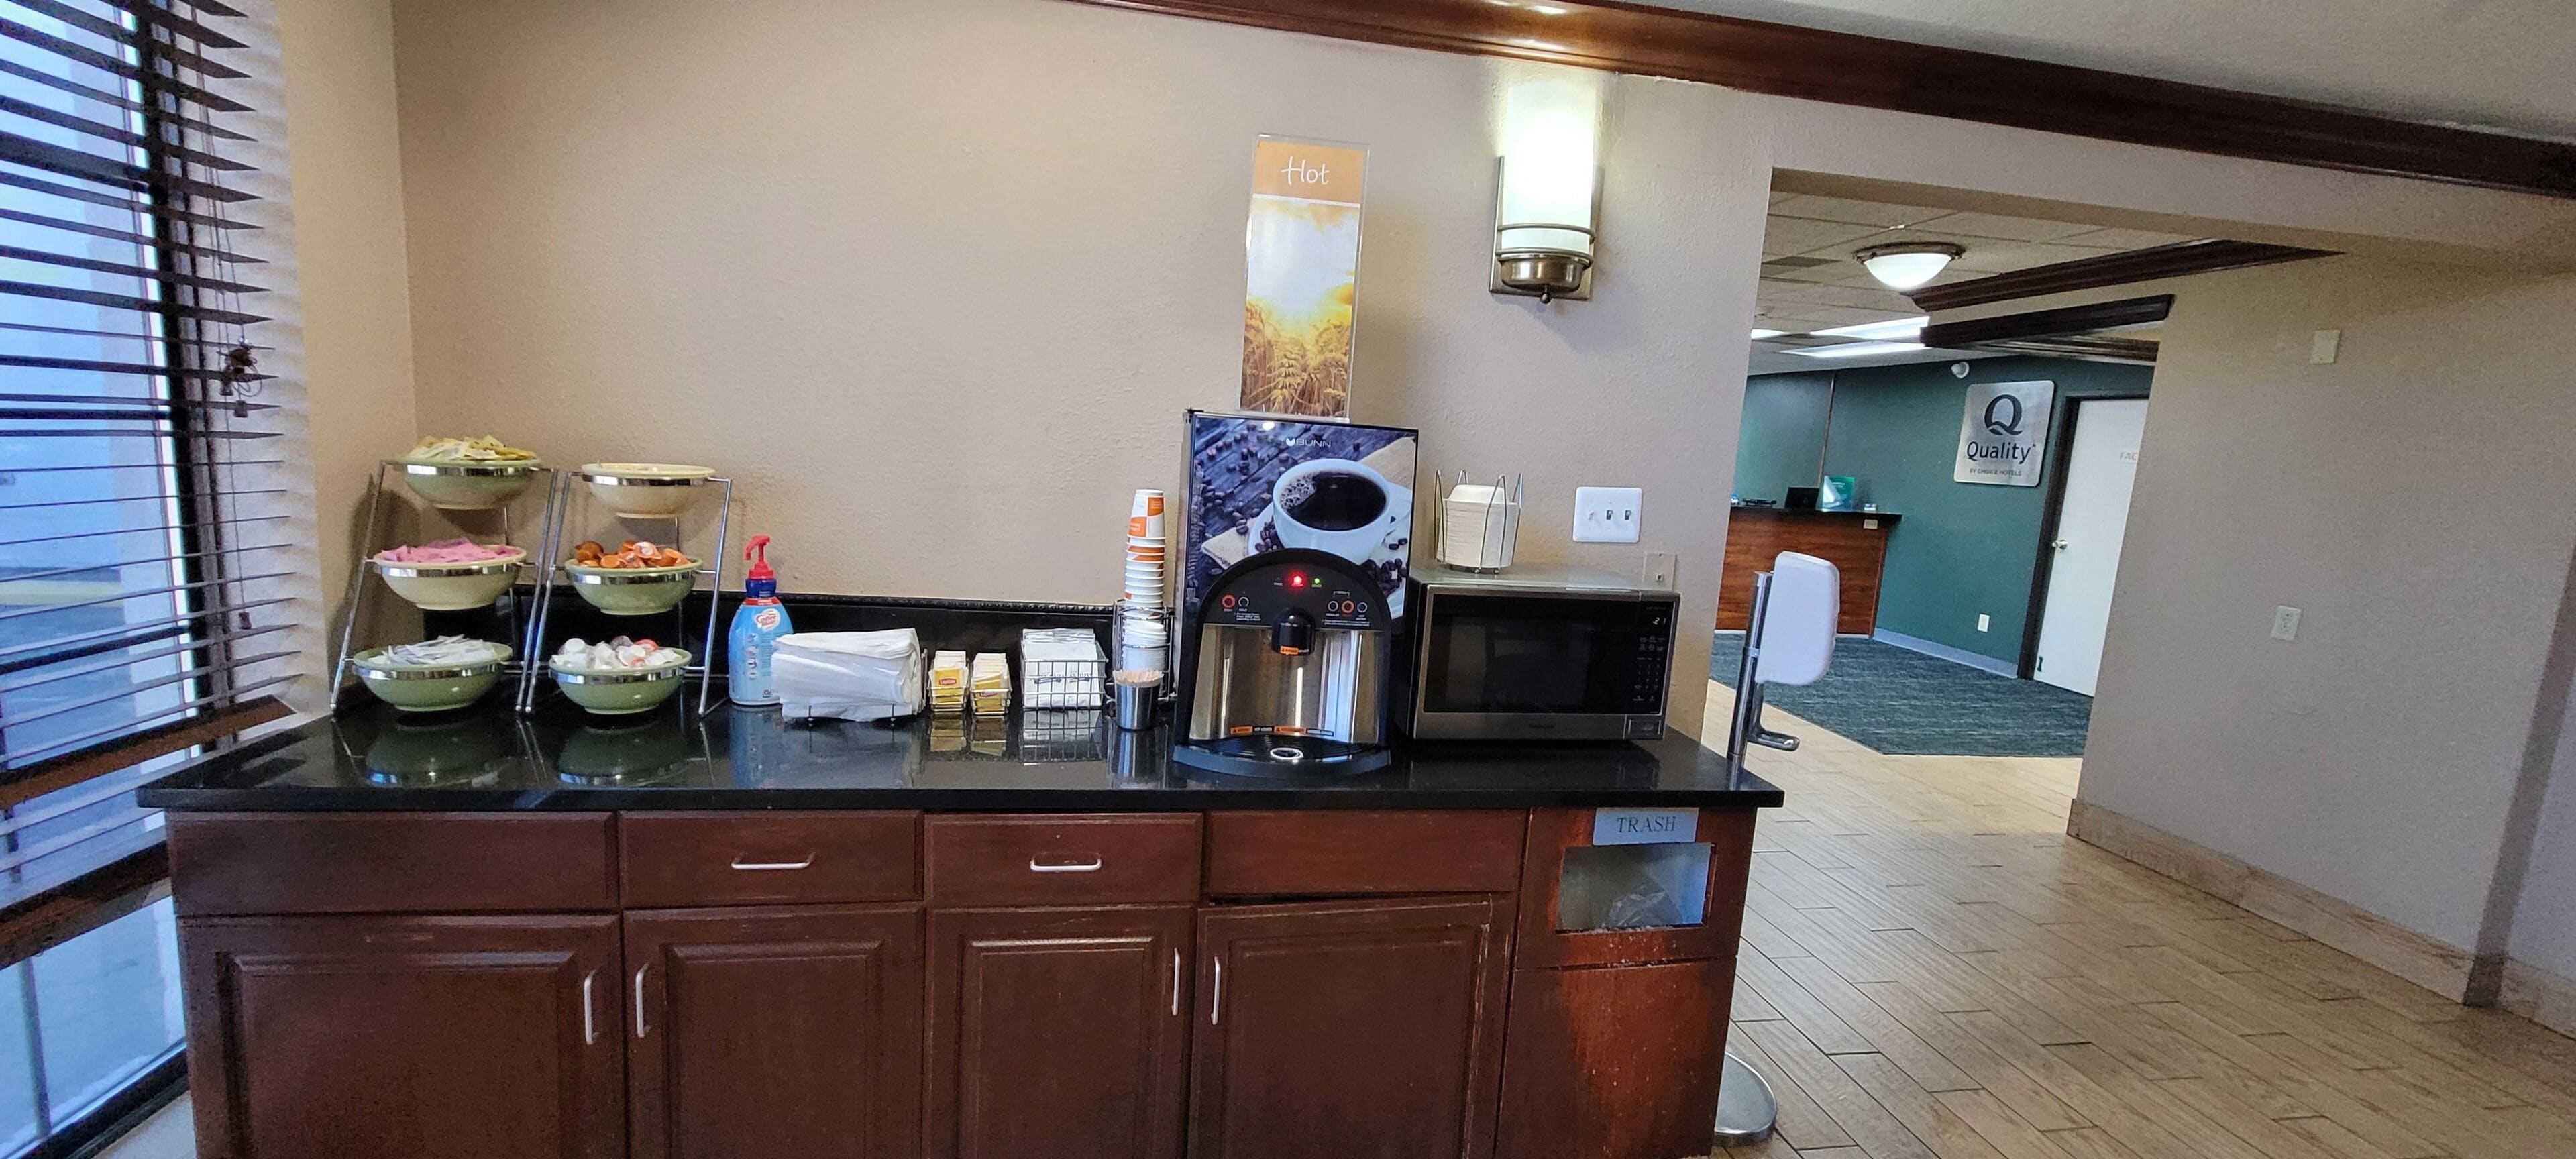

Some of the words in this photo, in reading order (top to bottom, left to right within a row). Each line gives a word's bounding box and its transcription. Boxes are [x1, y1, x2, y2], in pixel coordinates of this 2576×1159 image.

[1281, 156, 1330, 185] Hot
[1984, 394, 2023, 435] Q
[1295, 439, 1332, 448] BUNN
[1966, 441, 2031, 465] Quality
[1617, 816, 1677, 833] TRASH
